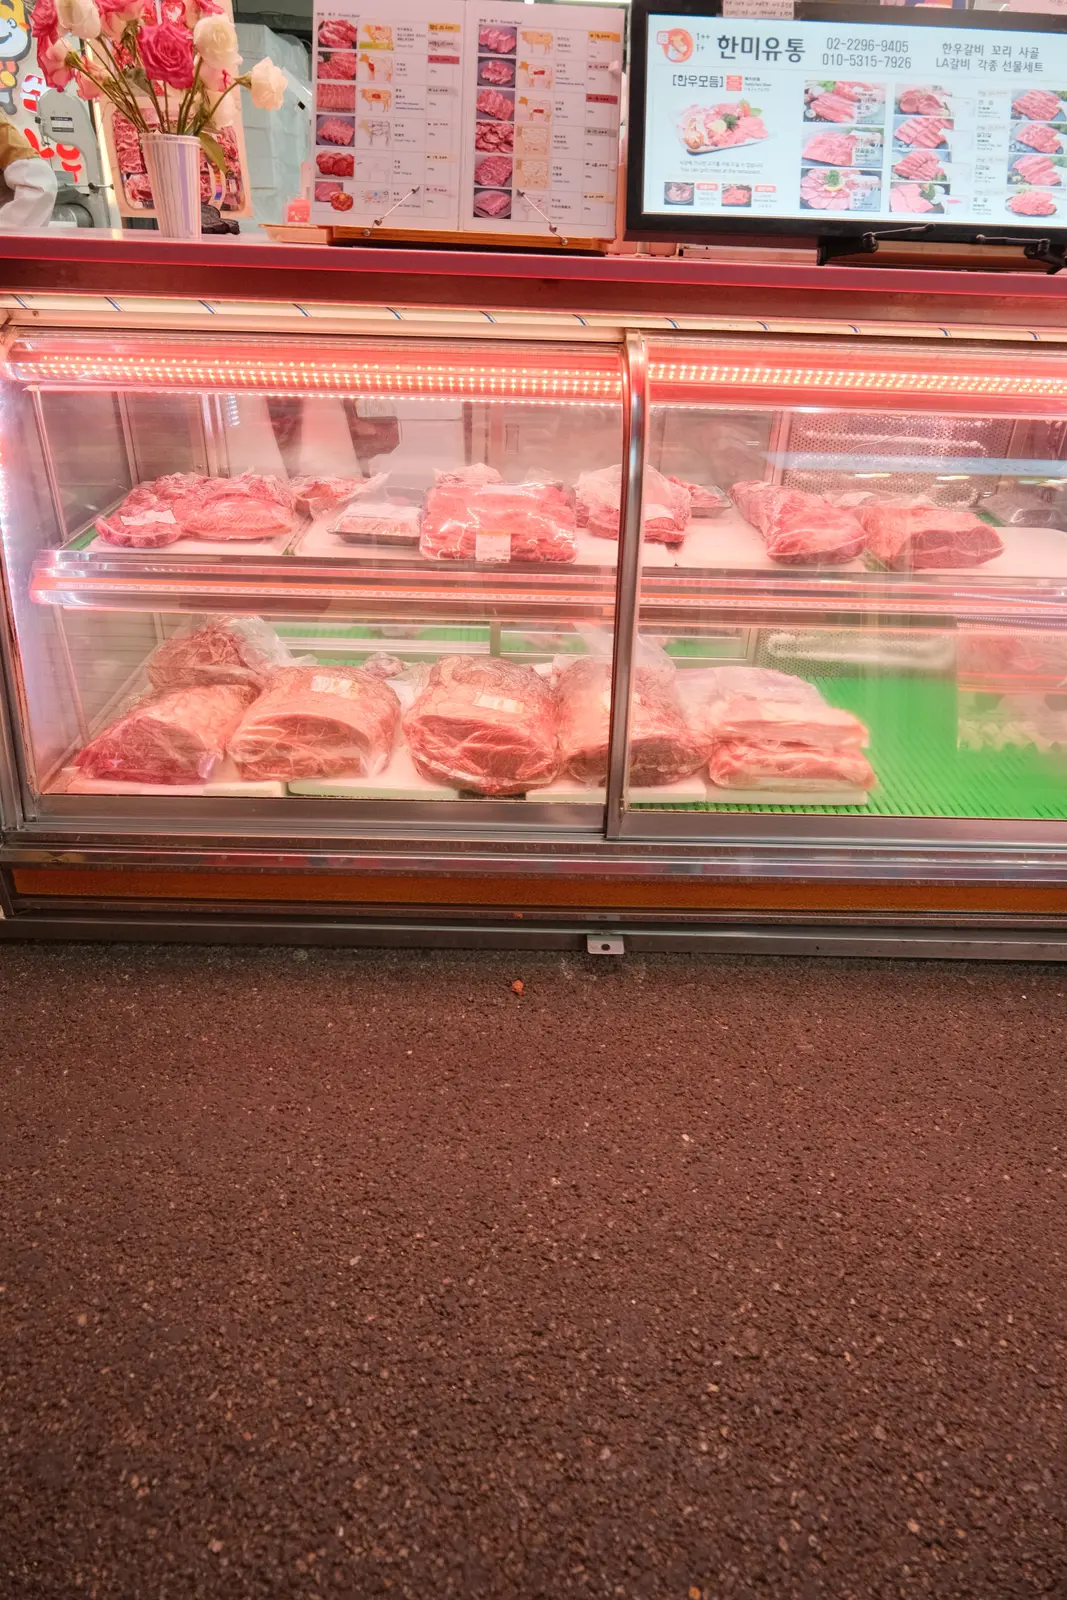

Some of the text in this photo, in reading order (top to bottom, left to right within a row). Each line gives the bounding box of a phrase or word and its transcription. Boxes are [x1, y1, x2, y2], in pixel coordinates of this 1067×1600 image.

[717, 34, 806, 63] 한미유통
[826, 37, 909, 53] 02-2296-9405
[942, 42, 1040, 60] 한우갈비 꼬리 사골
[822, 53, 912, 69] 010-5315-7926
[935, 57, 1044, 73] LA갈비 각종 선물세트
